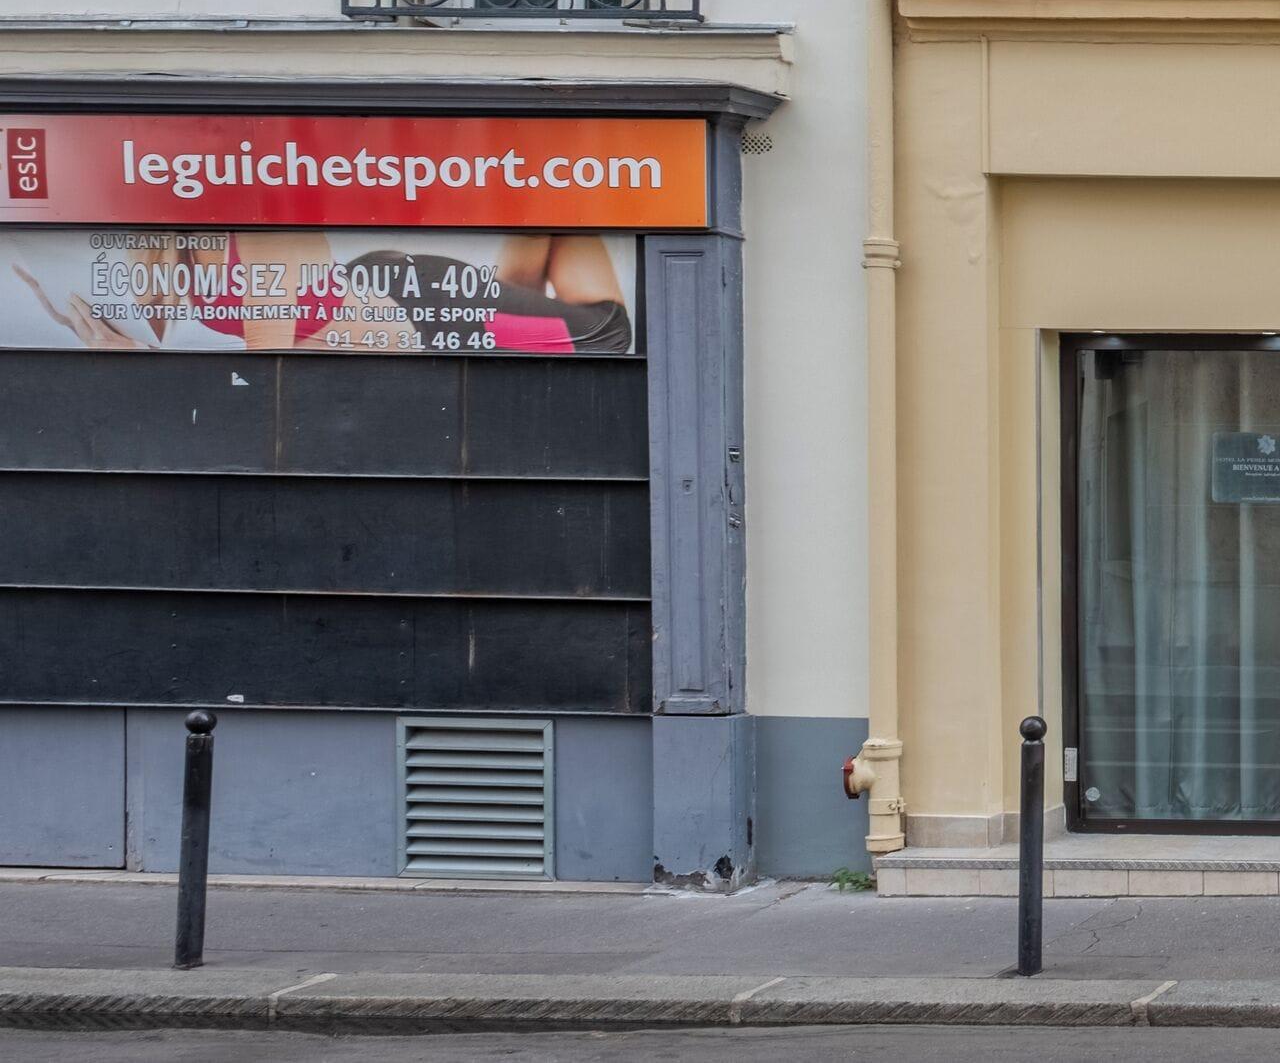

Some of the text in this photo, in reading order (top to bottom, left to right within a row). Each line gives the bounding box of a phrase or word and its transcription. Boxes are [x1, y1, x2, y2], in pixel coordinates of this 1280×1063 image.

[11, 136, 39, 192] eslc
[122, 139, 662, 202] leguichetsport.com
[90, 233, 228, 251] OUVRANT DROIT
[91, 251, 287, 298] ÉCONOMISEZ
[430, 264, 501, 300] -40%
[91, 302, 498, 323] SUR VOTRE ABONNEMENT À UN CLUB DE SPORT
[326, 329, 497, 350] 01 43 31 46 46
